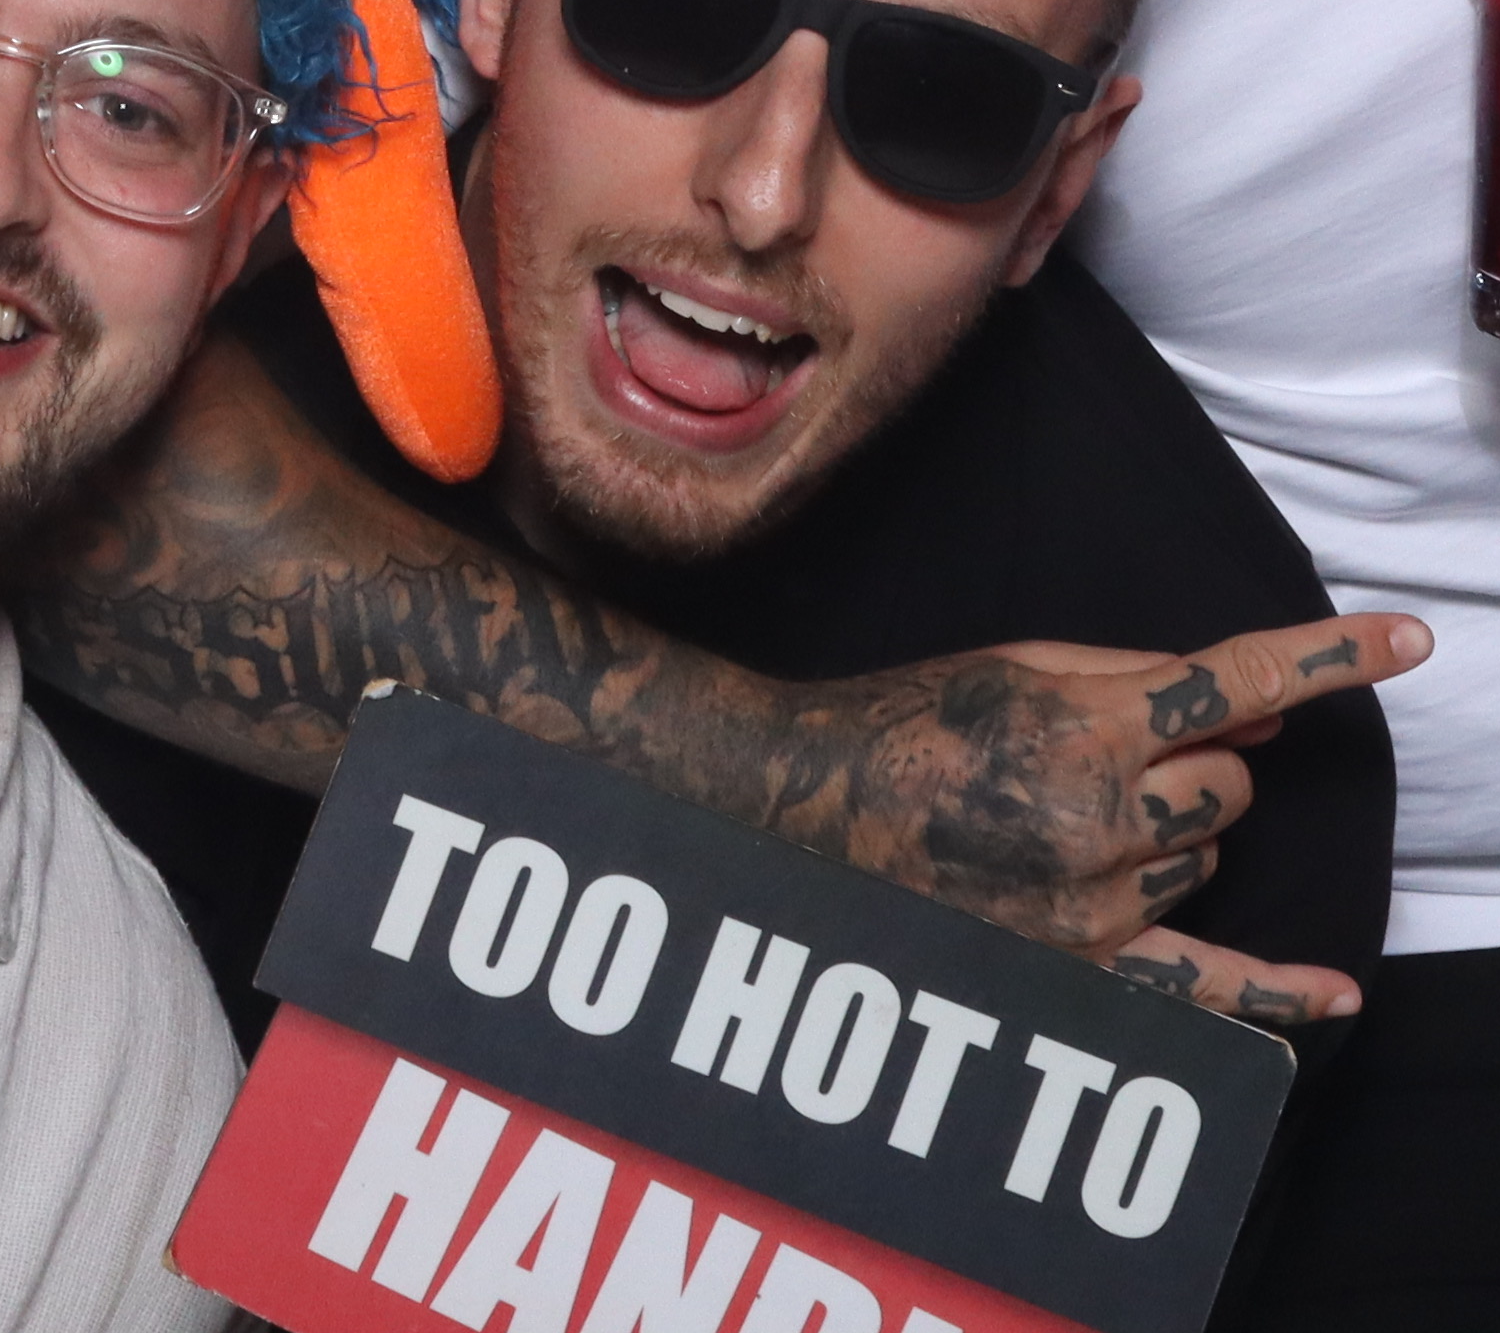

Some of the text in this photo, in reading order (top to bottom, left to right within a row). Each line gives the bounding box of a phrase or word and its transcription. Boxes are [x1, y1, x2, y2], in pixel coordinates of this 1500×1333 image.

[370, 792, 1202, 1240] TOO HOT TO
